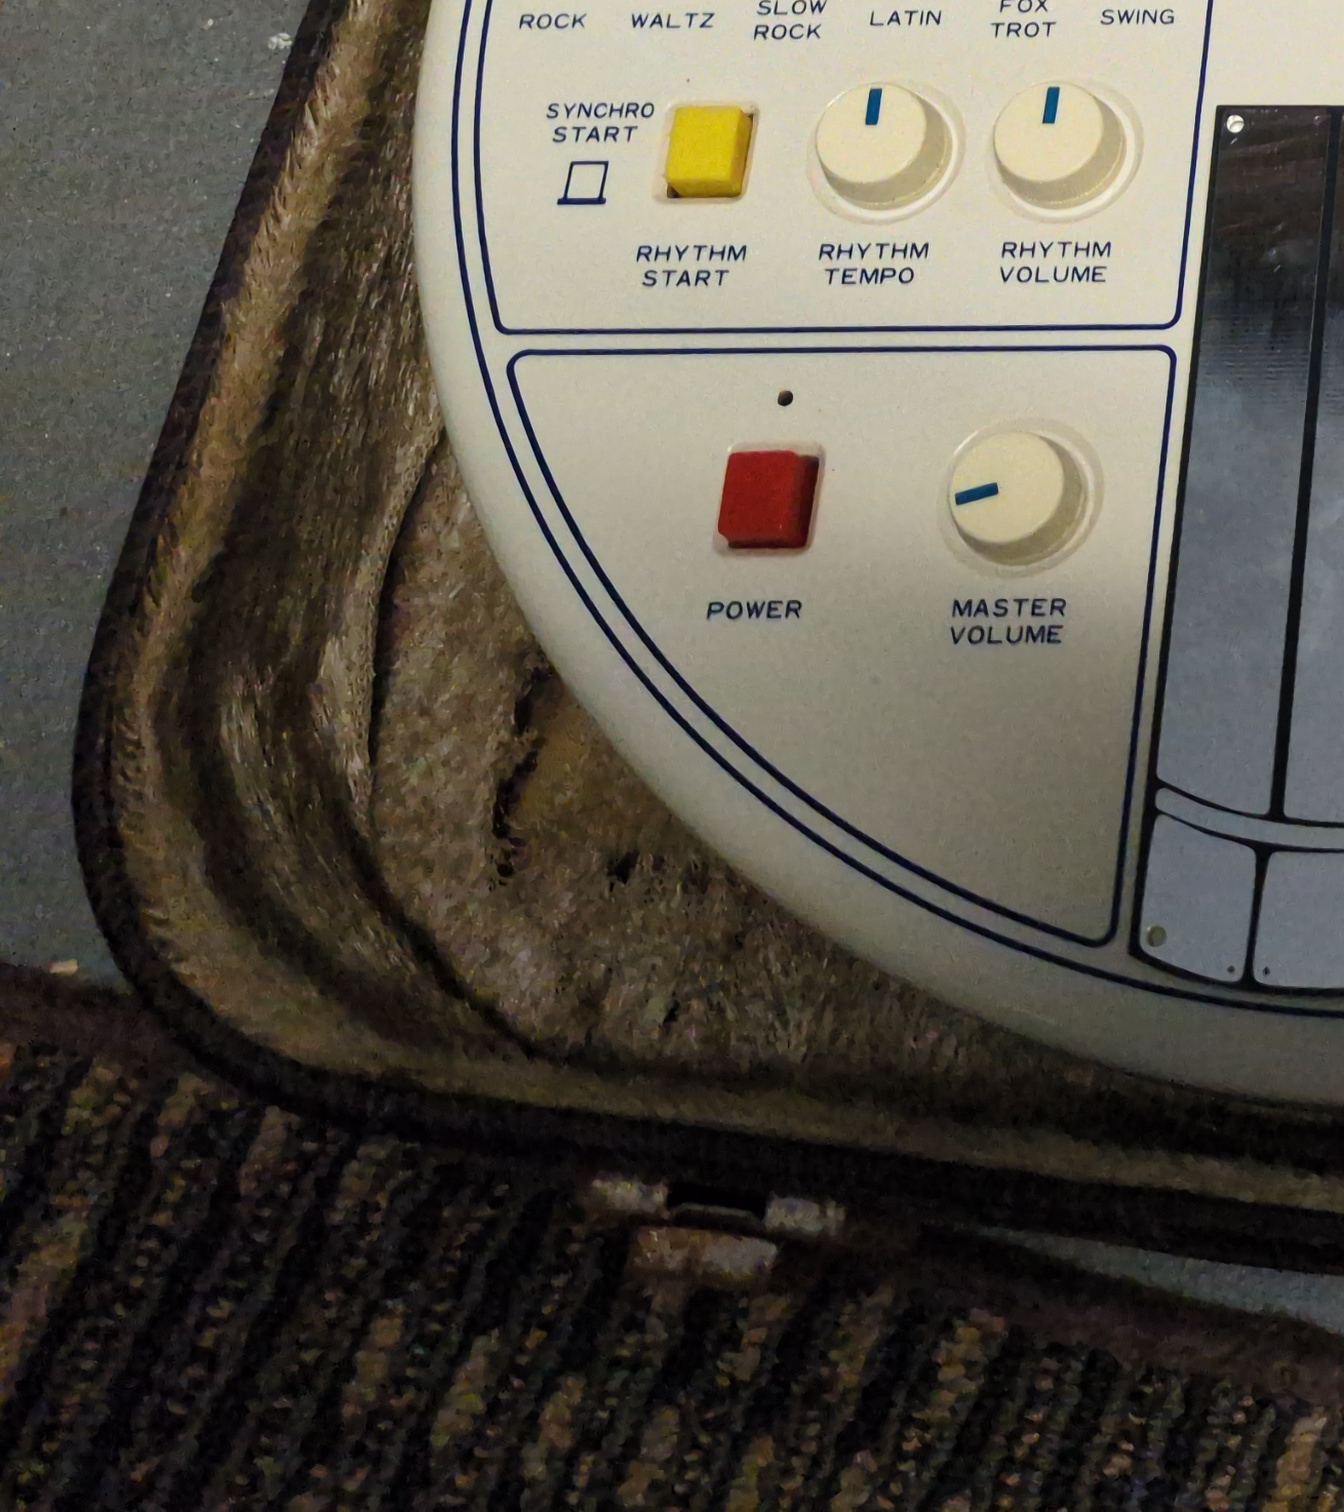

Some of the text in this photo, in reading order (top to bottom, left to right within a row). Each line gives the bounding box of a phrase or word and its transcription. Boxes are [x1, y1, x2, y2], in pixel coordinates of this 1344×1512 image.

[518, 13, 587, 30] ROCK
[631, 12, 715, 29] WALTZ
[869, 10, 942, 27] LATIN
[1100, 8, 1175, 26] SWING
[753, 23, 822, 41] ROCK
[991, 21, 1057, 38] TROT
[546, 102, 655, 120] SYNCHRO
[552, 125, 639, 144] START
[636, 244, 747, 263] RHYTHM
[818, 242, 930, 261] RHYTHM
[1001, 241, 1112, 259] RHYTHM
[641, 269, 730, 288] START
[824, 266, 915, 285] TEMPO
[999, 265, 1107, 284] VOLUME
[706, 599, 803, 621] POWER
[951, 597, 1067, 618] MASTER
[950, 624, 1064, 646] VOLUME
